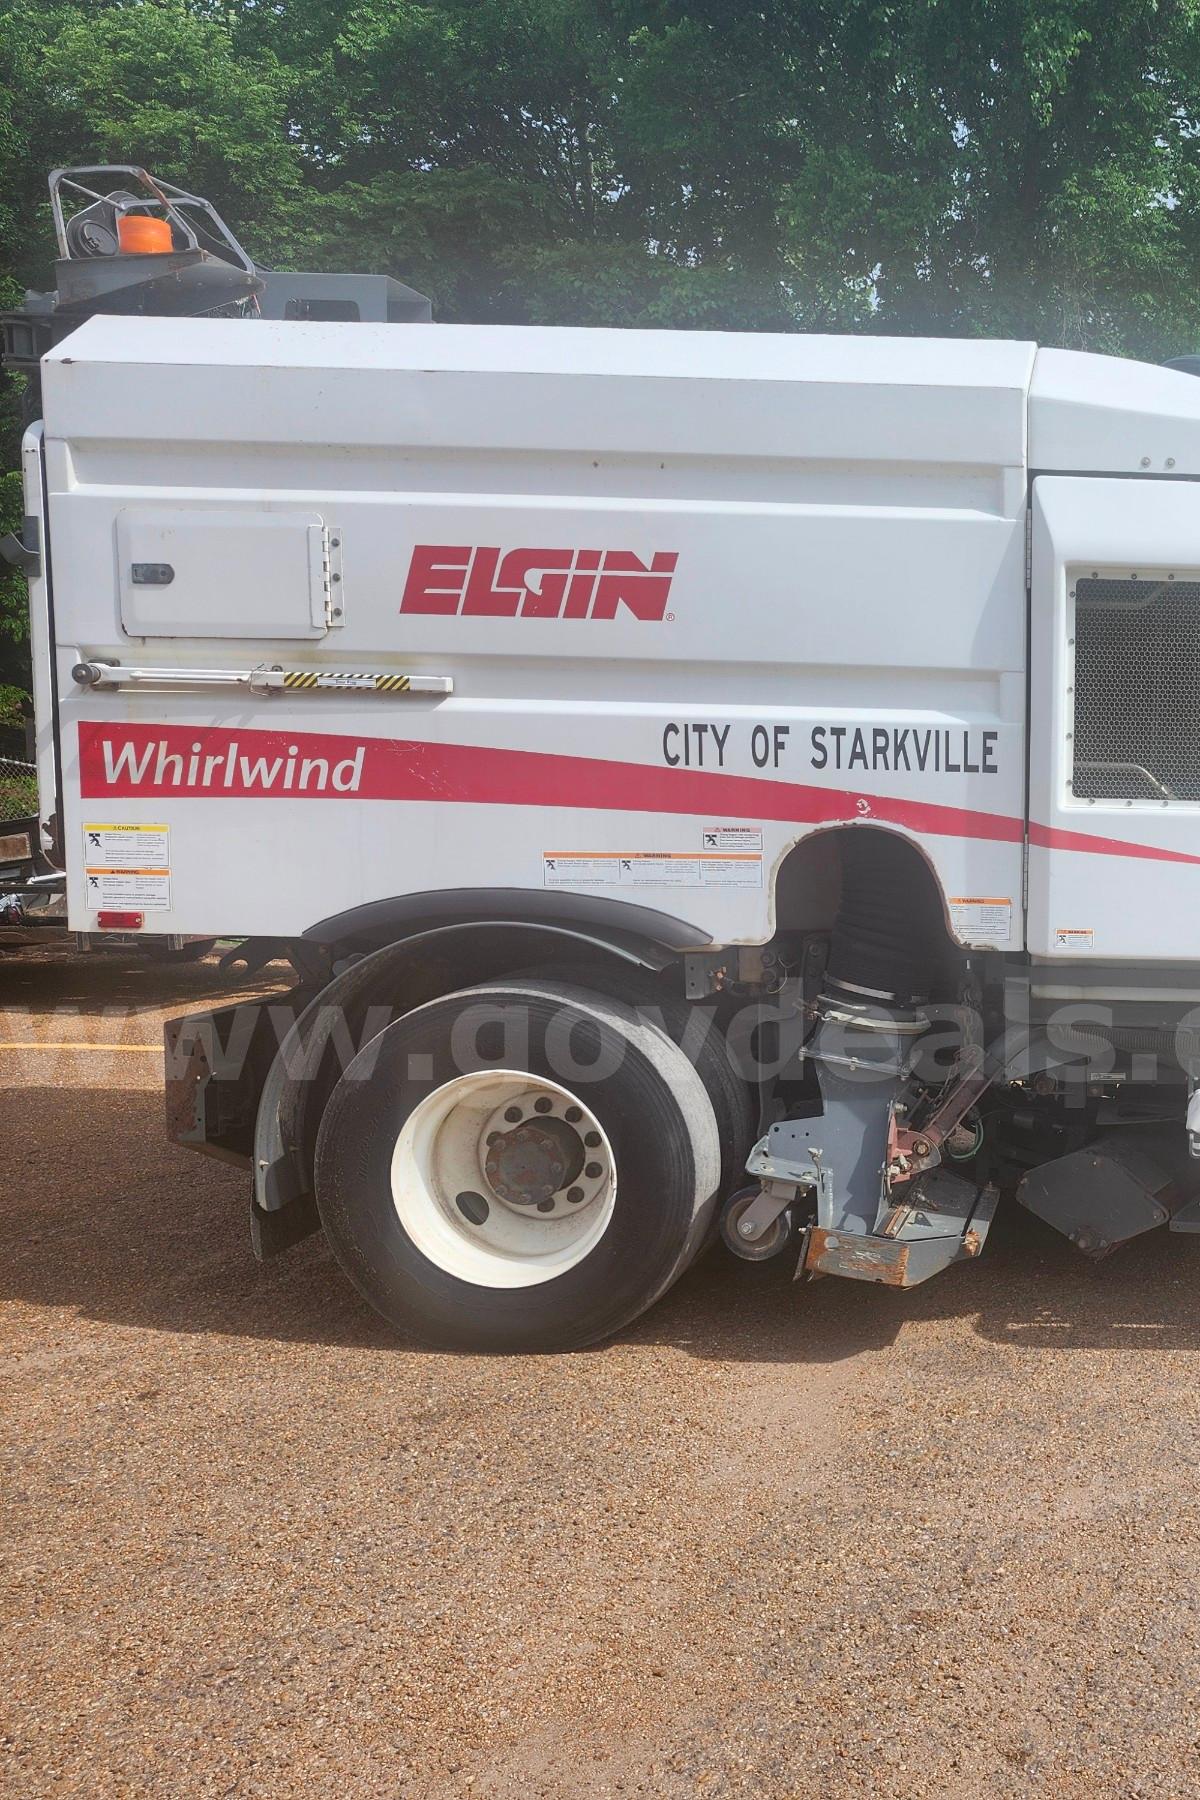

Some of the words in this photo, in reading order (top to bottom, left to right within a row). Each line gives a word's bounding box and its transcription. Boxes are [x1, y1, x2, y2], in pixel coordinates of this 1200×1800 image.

[400, 544, 679, 621] ELGIN
[102, 740, 366, 792] Whirlwind
[662, 722, 731, 767] CITY
[751, 724, 790, 768] OF
[810, 725, 998, 773] STARKVILLE
